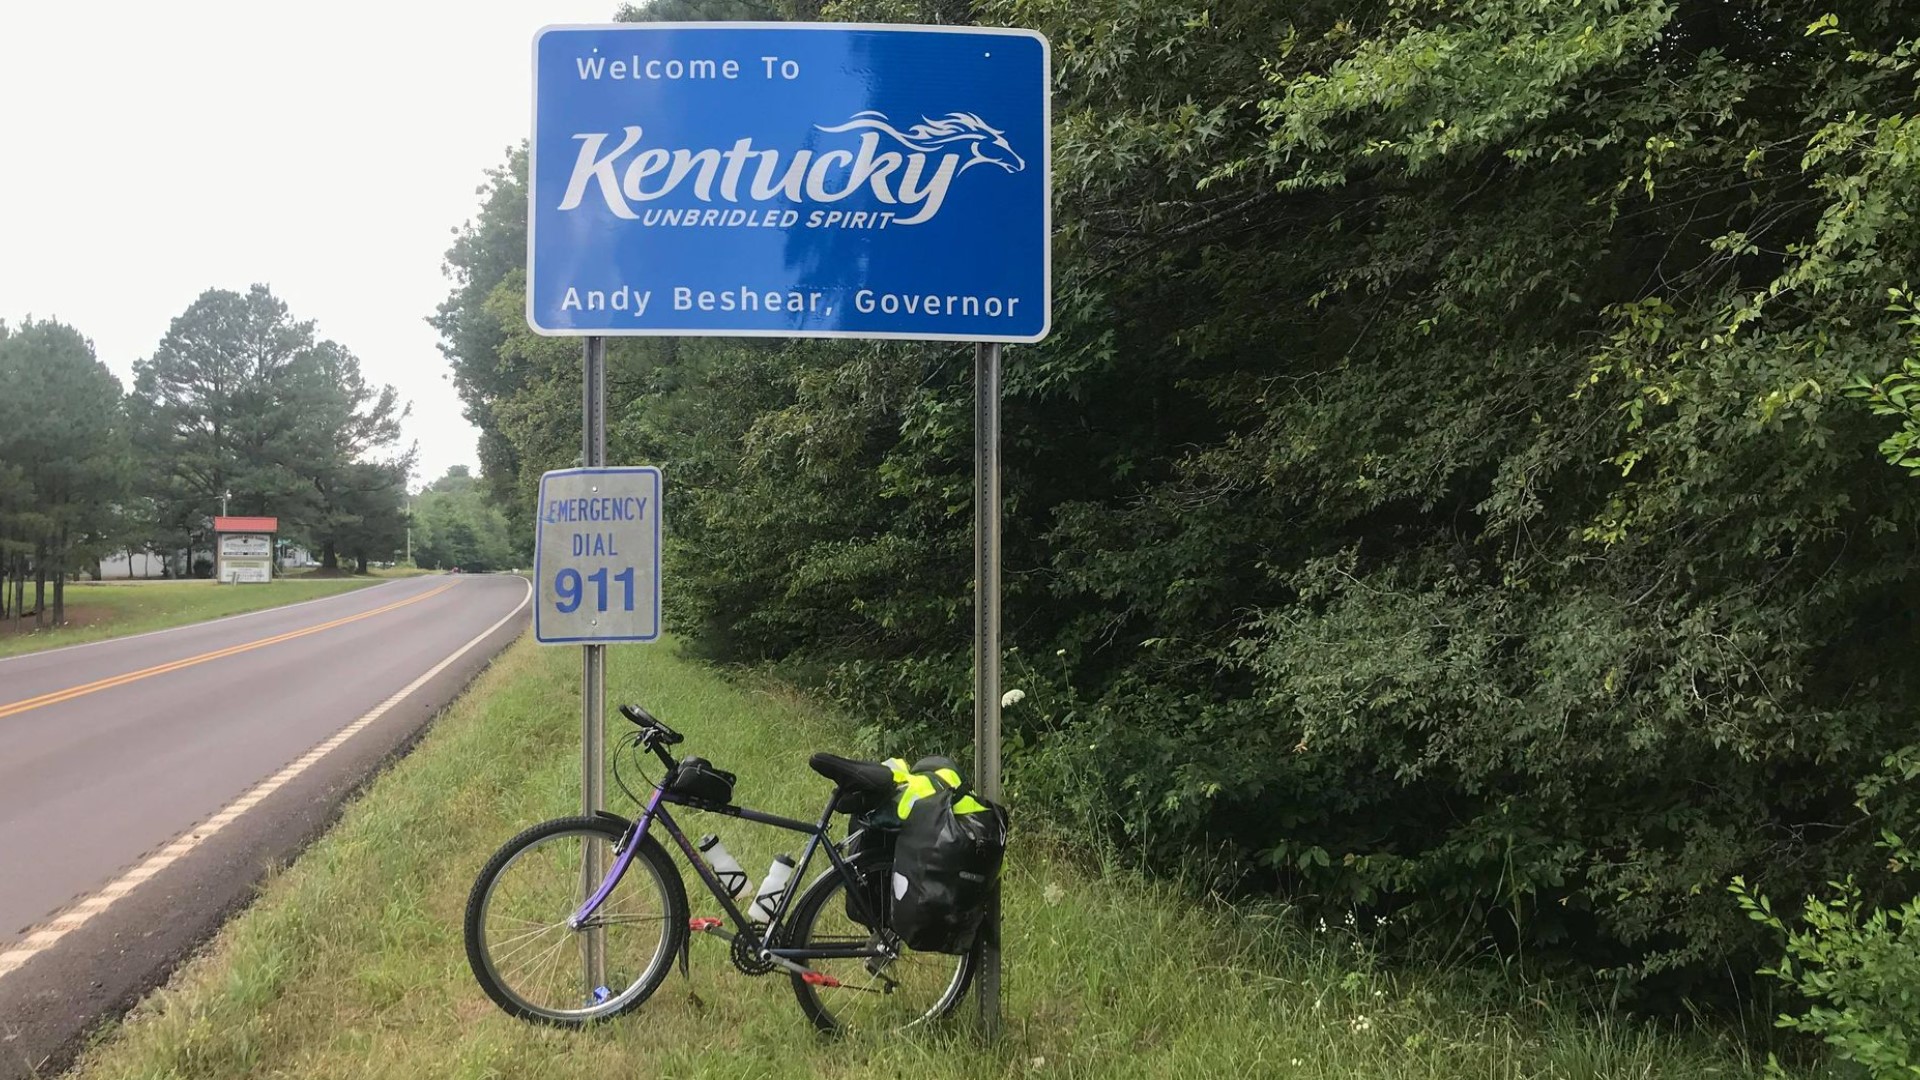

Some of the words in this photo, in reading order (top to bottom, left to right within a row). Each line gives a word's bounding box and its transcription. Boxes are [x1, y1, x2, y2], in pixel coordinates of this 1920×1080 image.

[577, 54, 740, 80] Welcome
[762, 56, 800, 80] To
[557, 125, 960, 225] Kentucky
[643, 208, 799, 228] UNBRIDLED
[806, 209, 895, 230] SPIRIT
[561, 286, 651, 316] Andy
[674, 287, 832, 317] Beshear,
[855, 289, 1020, 317] Governor
[550, 497, 647, 522] EMERGENCY
[572, 533, 618, 557] DIAL
[554, 567, 634, 613] 911
